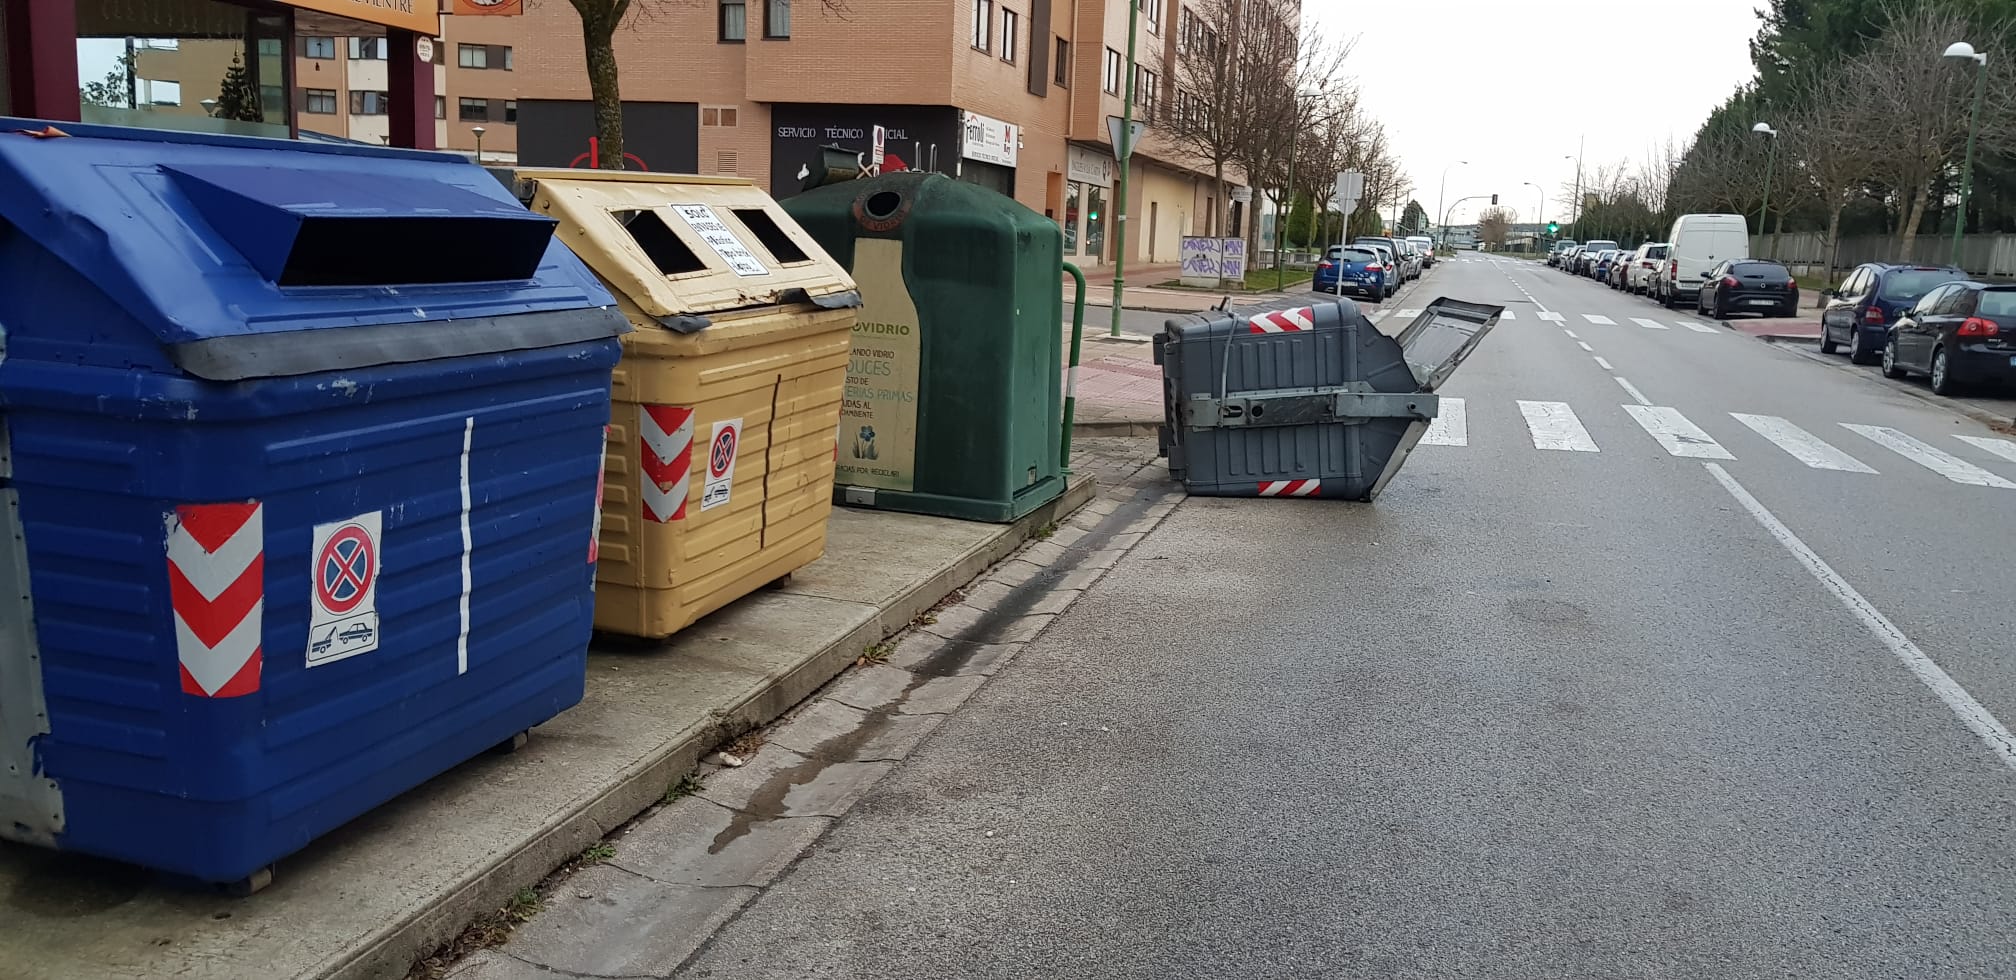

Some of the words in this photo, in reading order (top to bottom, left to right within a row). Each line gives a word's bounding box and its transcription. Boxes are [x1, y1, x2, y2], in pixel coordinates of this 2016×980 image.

[778, 127, 816, 138] SERVICIO
[824, 125, 864, 139] TÉCNICO
[965, 118, 984, 144] Ferroli
[852, 321, 910, 335] OVIDRIO
[849, 347, 872, 357] ANDO
[872, 349, 895, 359] VIDRIO
[846, 359, 892, 376] DUCES
[845, 376, 859, 385] STO
[860, 377, 869, 386] DE
[845, 385, 874, 400] ERIAS
[877, 388, 913, 403] PRIMAS
[842, 399, 862, 409] UDAS
[863, 401, 872, 410] AL
